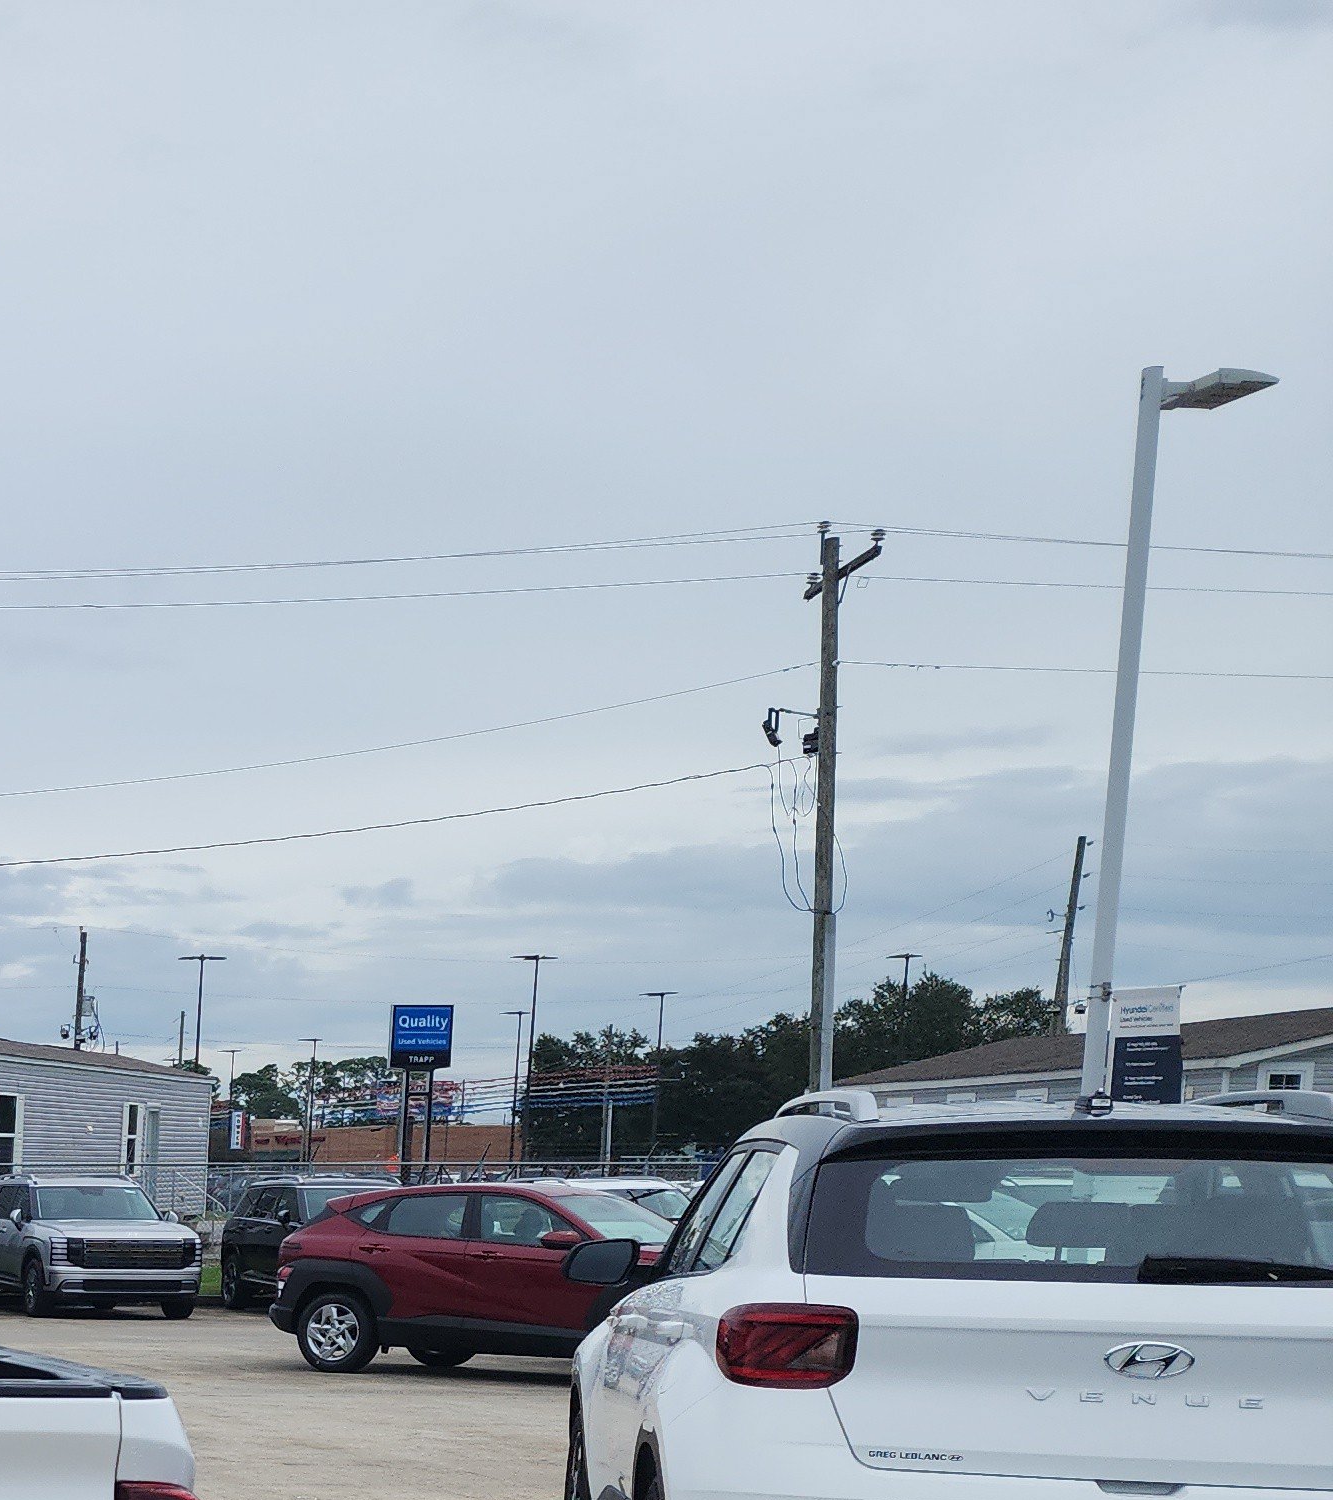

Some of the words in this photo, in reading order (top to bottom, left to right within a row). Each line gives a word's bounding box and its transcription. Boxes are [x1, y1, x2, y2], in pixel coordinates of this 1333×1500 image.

[398, 1014, 449, 1031] Quality
[408, 1055, 435, 1063] TRAPP
[1026, 1387, 1265, 1410] VENUE
[868, 1450, 897, 1459] GREG
